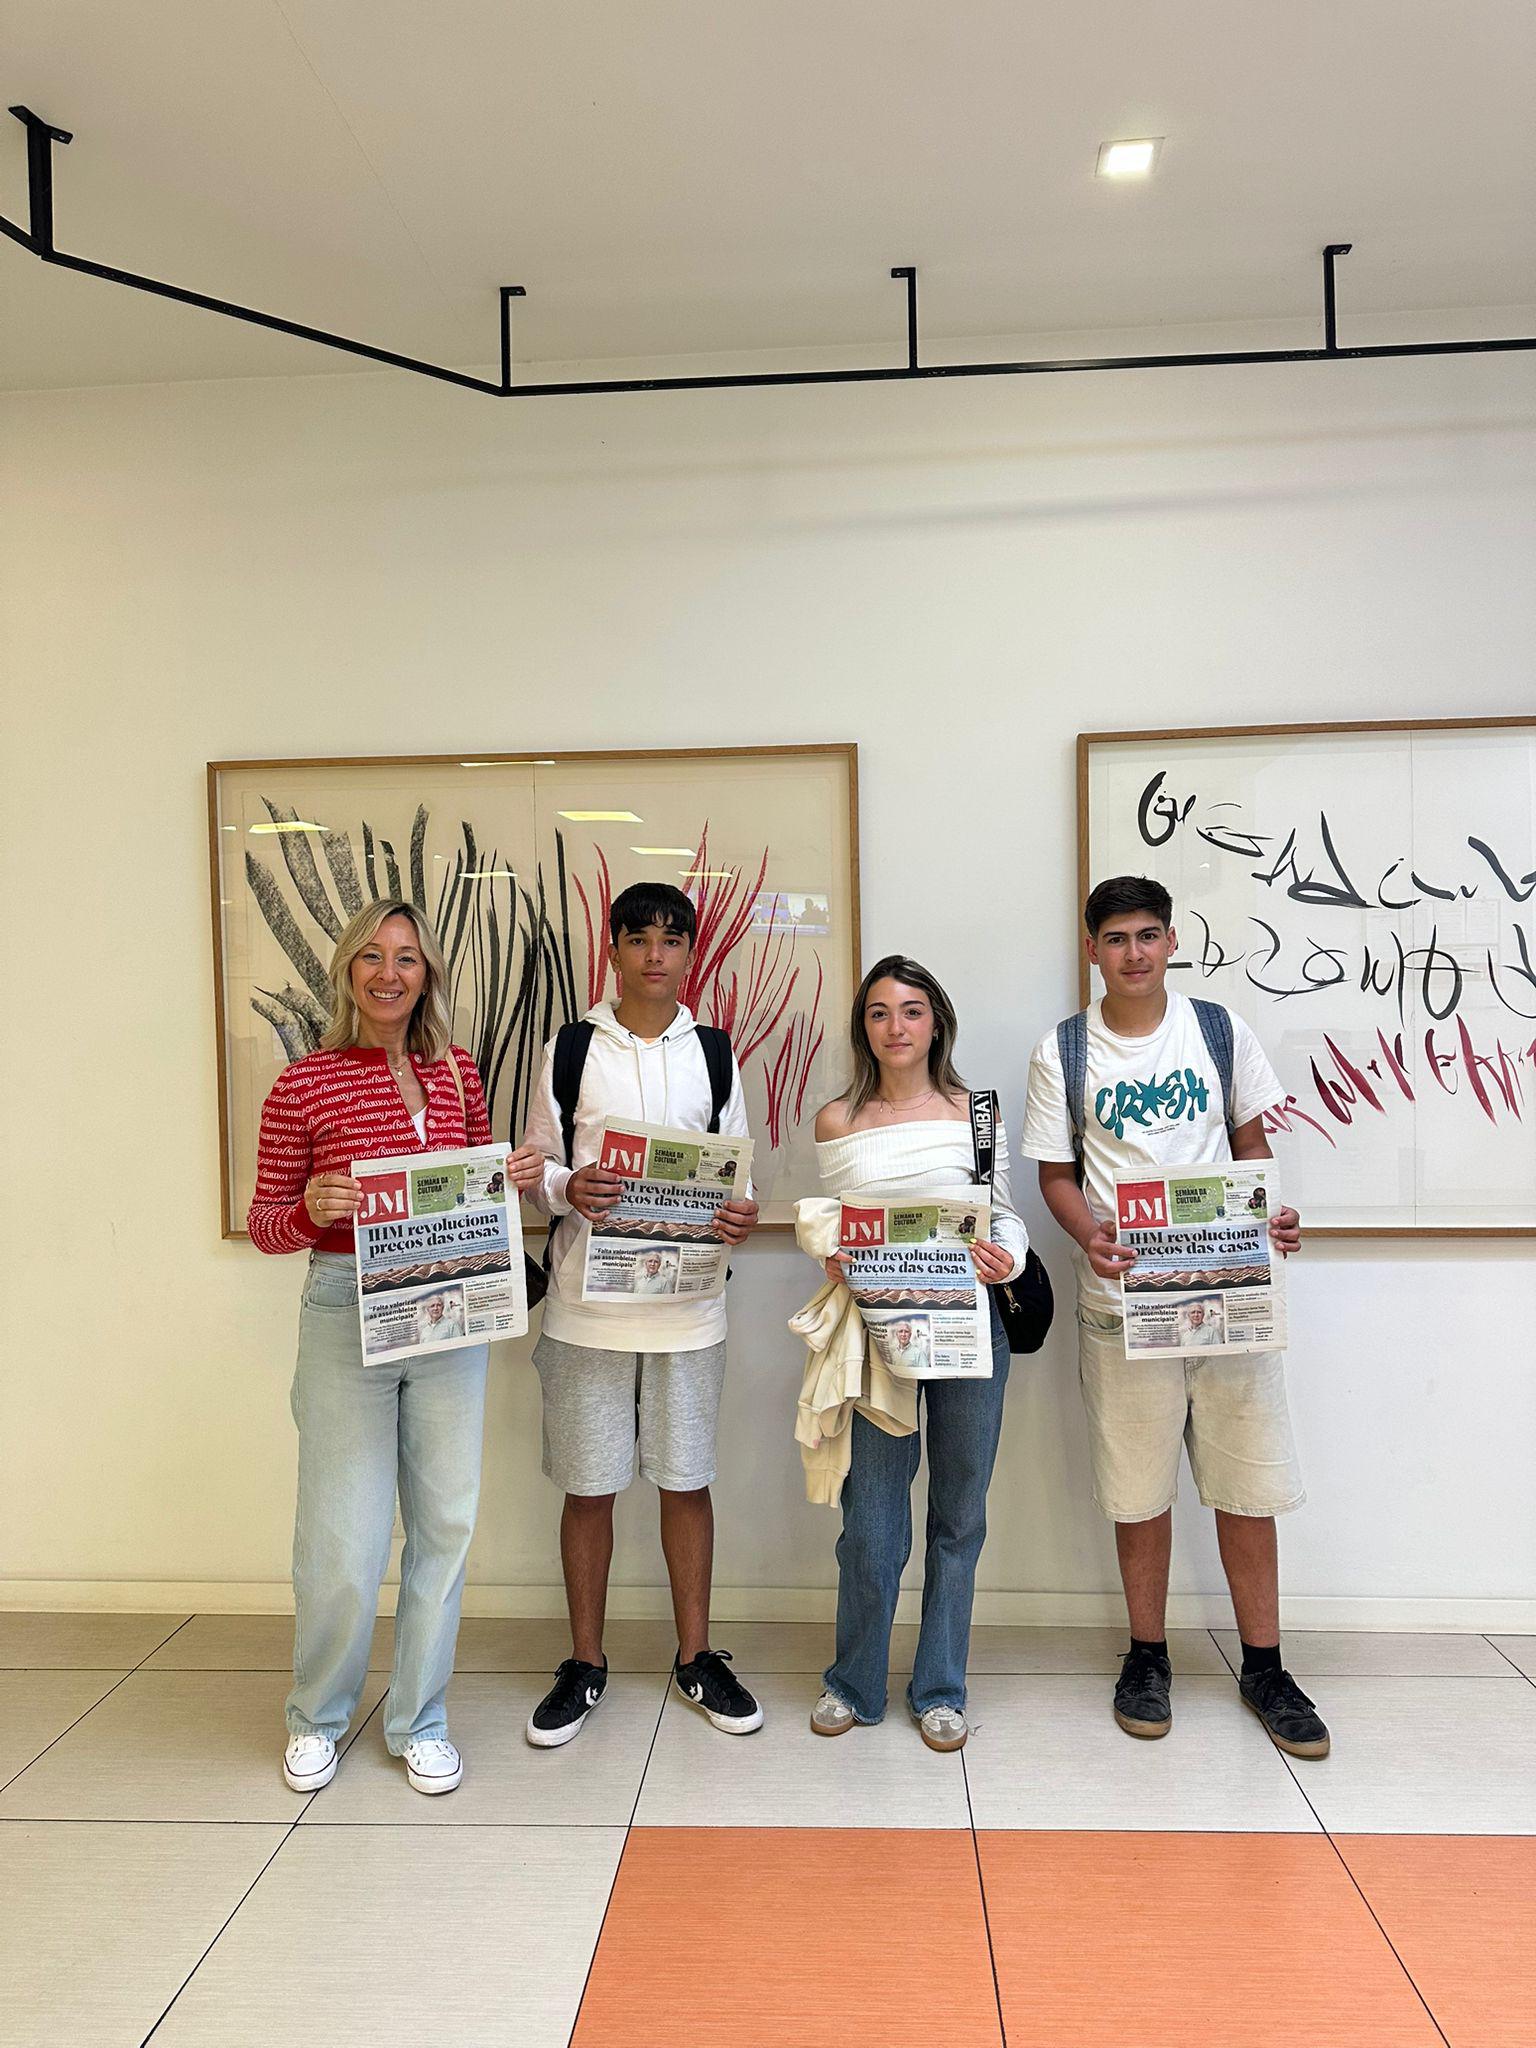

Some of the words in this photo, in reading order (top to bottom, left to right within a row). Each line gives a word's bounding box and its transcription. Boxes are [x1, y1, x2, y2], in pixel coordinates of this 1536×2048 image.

[601, 1147, 642, 1173] JM
[640, 1184, 723, 1200] revoluciona
[360, 1189, 405, 1219] JM
[620, 1194, 651, 1206] eços
[655, 1195, 679, 1207] das
[683, 1200, 722, 1210] casas
[1121, 1197, 1165, 1223] JM
[368, 1224, 403, 1242] IHM
[408, 1213, 498, 1236] revoluciona
[842, 1220, 882, 1241] JM
[1129, 1232, 1162, 1244] IHM
[1167, 1228, 1258, 1243] revoluciona
[369, 1239, 424, 1259] preços
[427, 1232, 455, 1246] das
[458, 1225, 500, 1241] casas
[1186, 1242, 1215, 1254] das
[1218, 1240, 1259, 1253] casas
[883, 1249, 966, 1262] revoluciona
[849, 1263, 895, 1276] preços
[899, 1261, 924, 1273] das
[927, 1264, 967, 1274] casas
